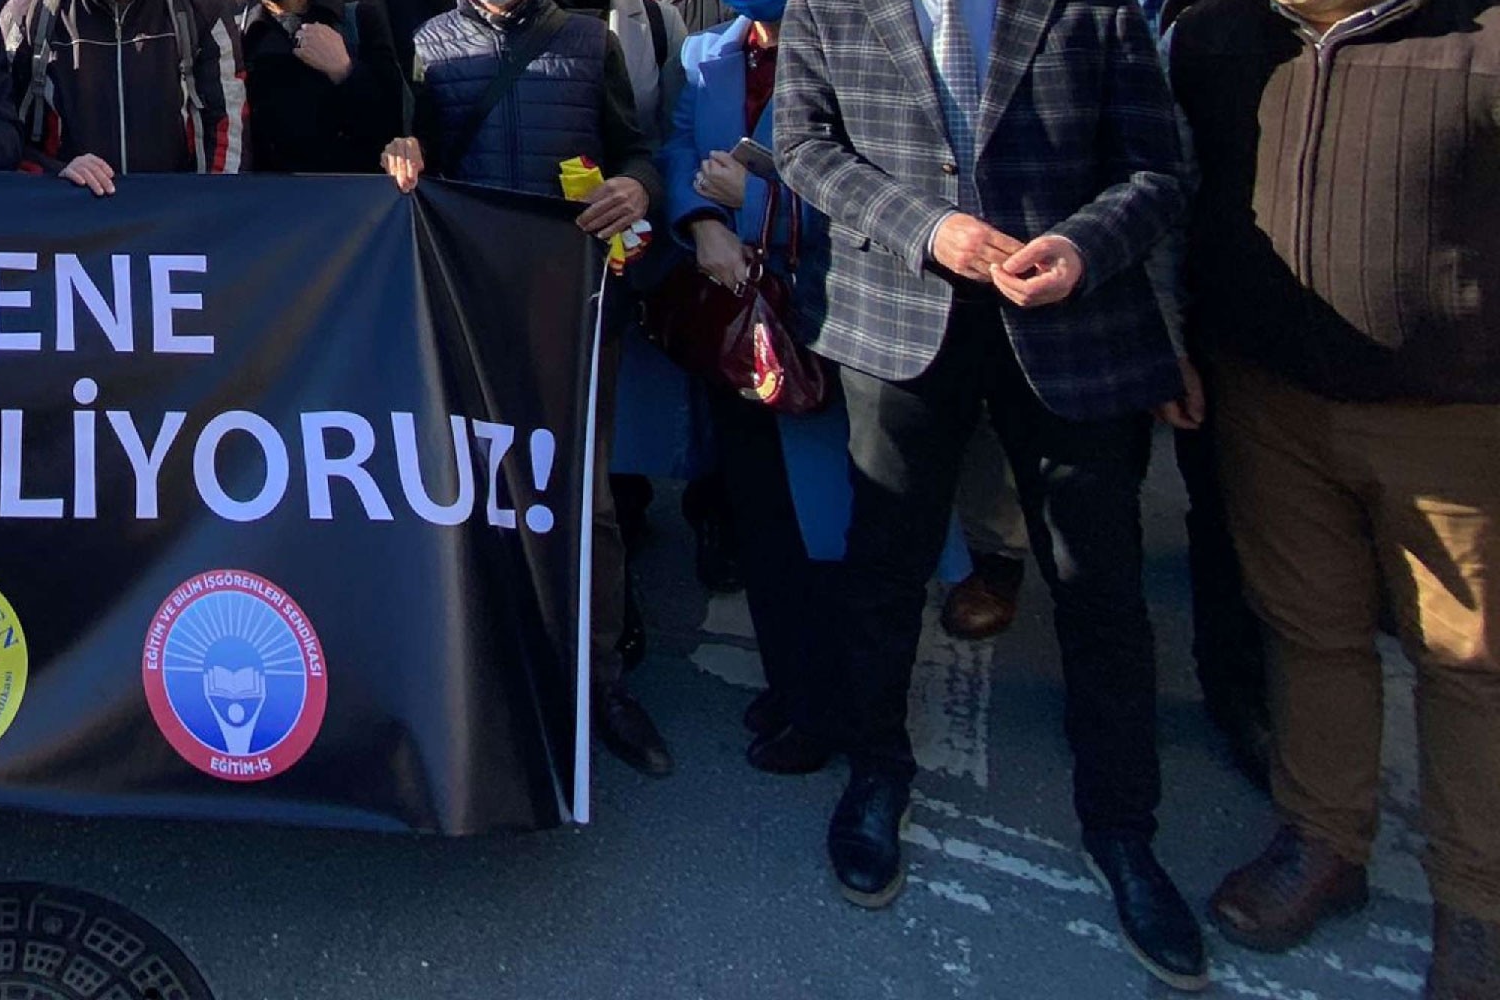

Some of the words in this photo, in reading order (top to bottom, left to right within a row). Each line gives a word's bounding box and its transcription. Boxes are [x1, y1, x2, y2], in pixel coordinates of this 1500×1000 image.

[145, 623, 166, 670] EĞİTİM
[160, 603, 175, 622] VE
[172, 580, 203, 607] BİLİM
[203, 572, 287, 608] İŞGÖRENLERİ
[282, 606, 323, 677] SENDİKASI
[210, 756, 272, 775] EĞİTİM-İŞ
